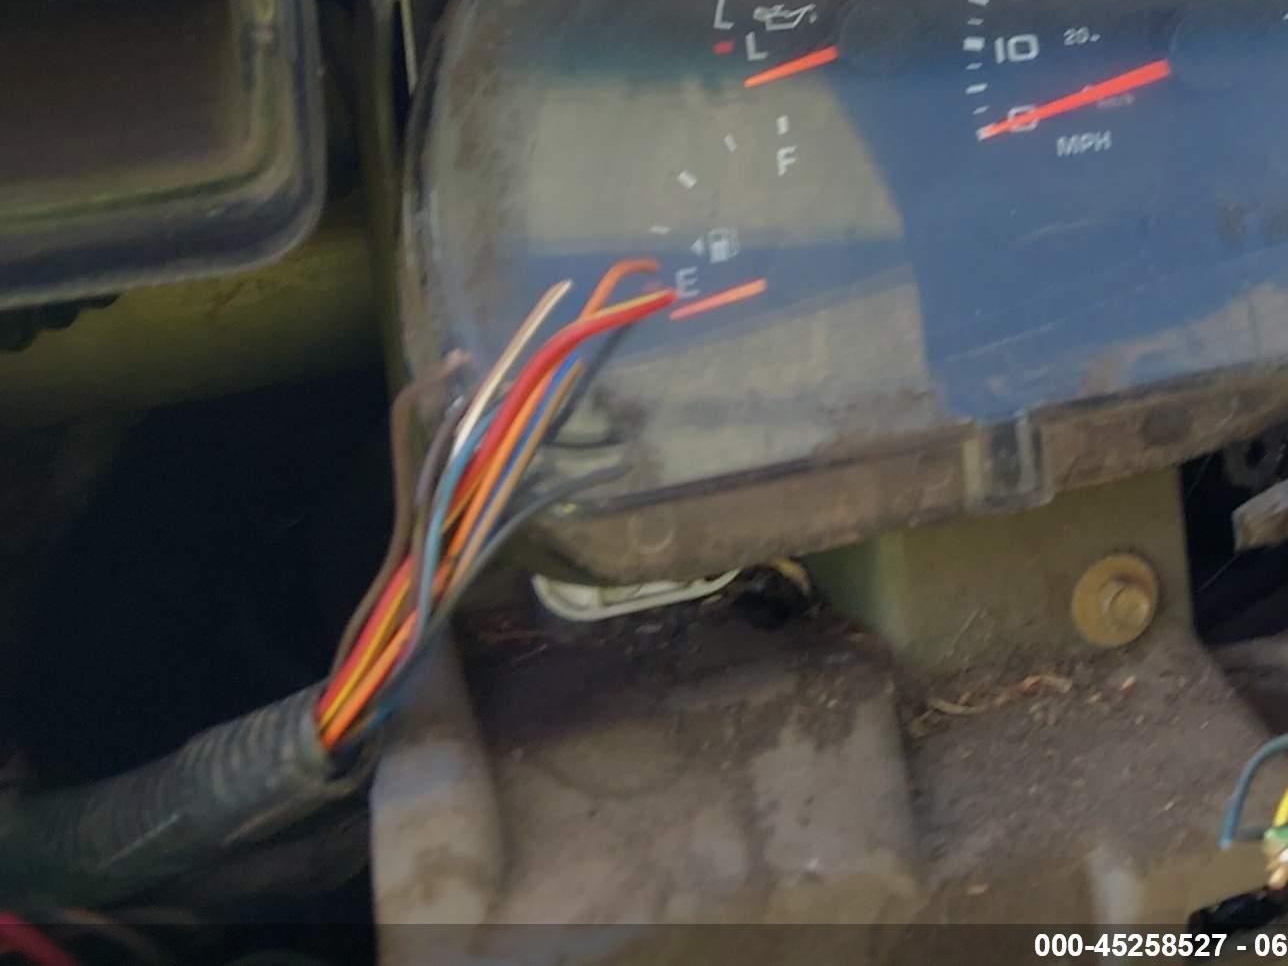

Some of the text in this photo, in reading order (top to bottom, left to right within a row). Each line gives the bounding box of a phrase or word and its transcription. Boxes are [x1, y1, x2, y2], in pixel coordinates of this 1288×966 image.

[745, 32, 770, 61] L
[994, 34, 1040, 64] 10
[1056, 130, 1112, 157] MPH
[776, 145, 798, 177] F
[675, 266, 701, 298] E
